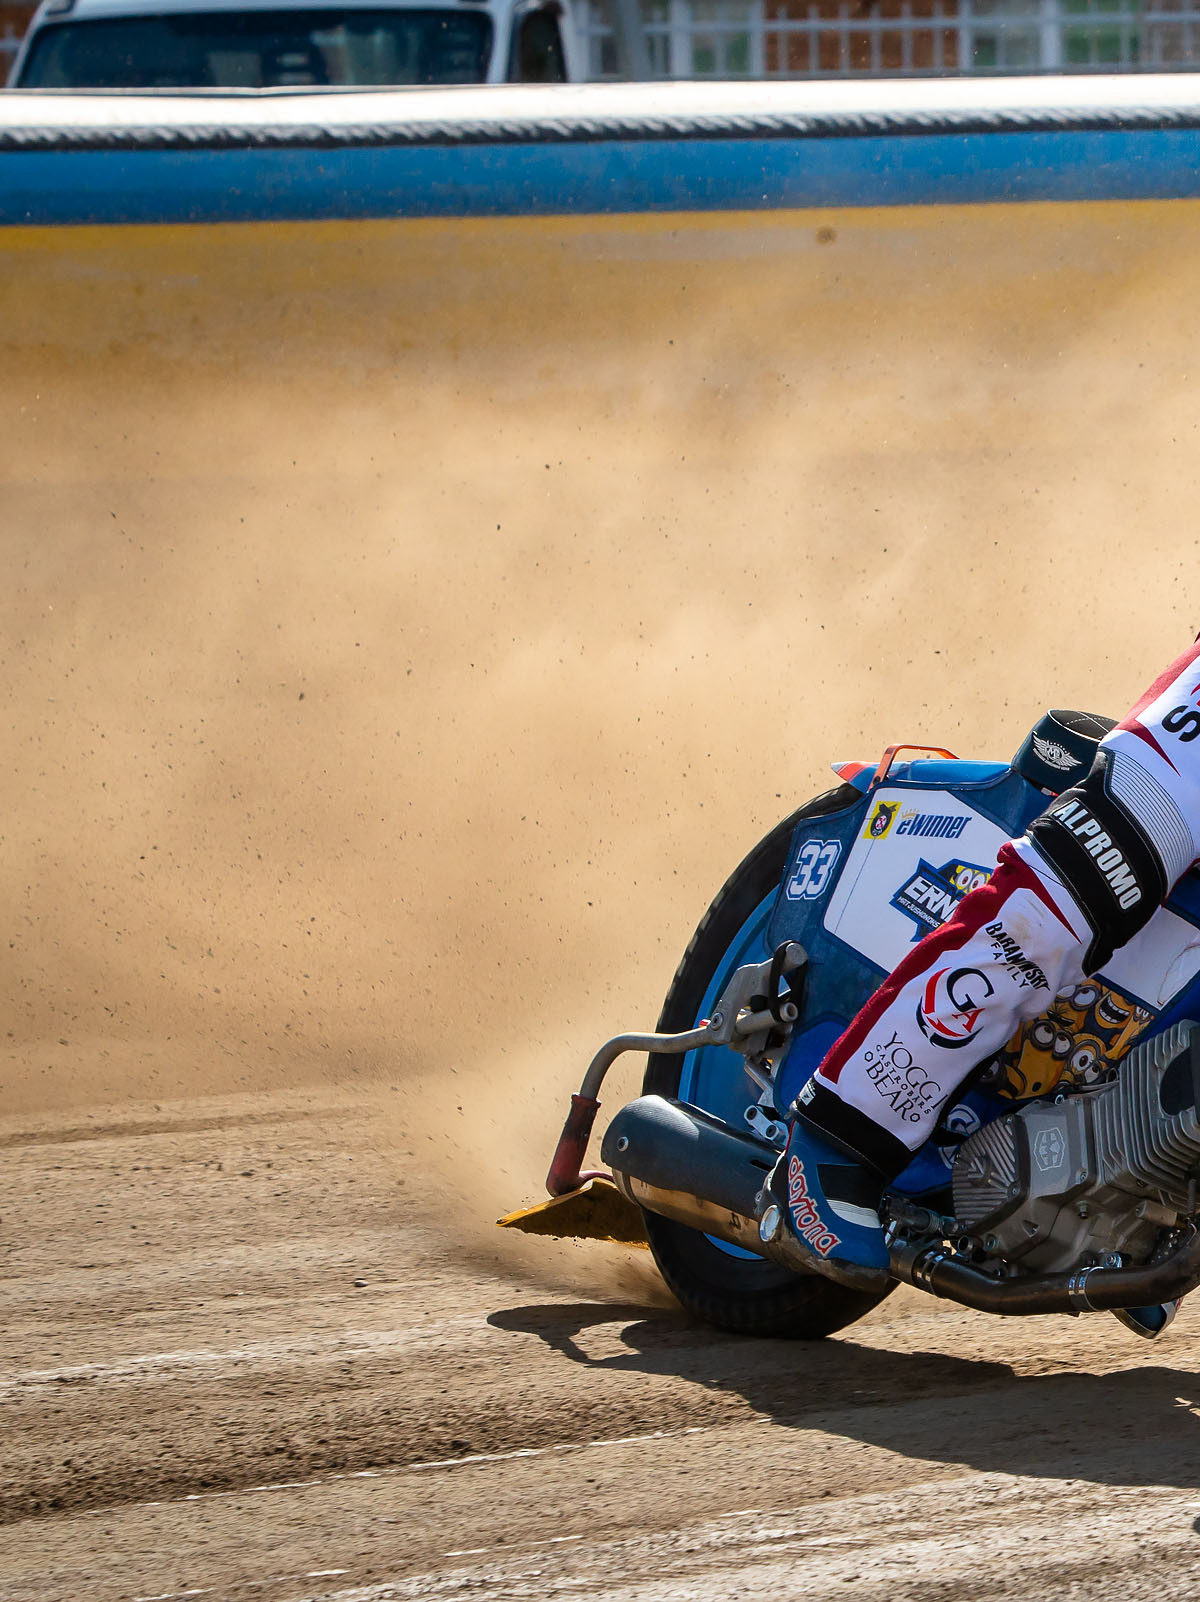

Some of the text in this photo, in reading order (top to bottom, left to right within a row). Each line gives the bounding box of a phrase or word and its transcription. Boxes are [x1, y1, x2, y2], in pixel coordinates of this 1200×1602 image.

[785, 839, 843, 900] 33
[1053, 800, 1142, 911] ALPROMO
[903, 875, 961, 923] ERN
[865, 1060, 914, 1121] BEAR
[883, 1030, 949, 1110] YOGGI
[788, 1154, 843, 1257] daytona
